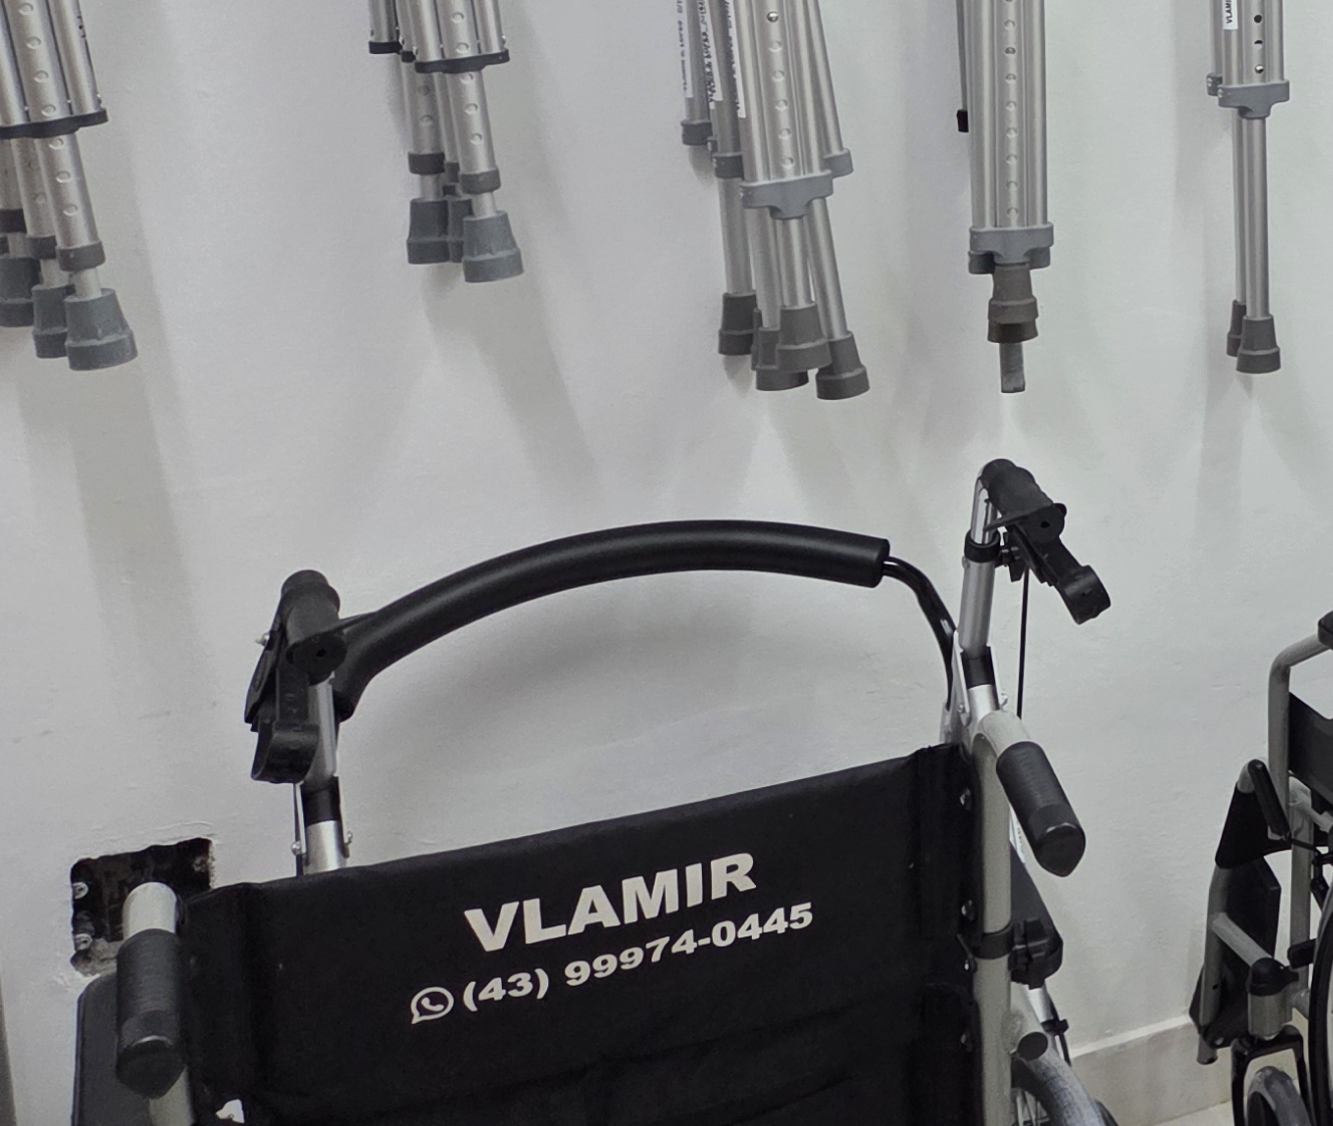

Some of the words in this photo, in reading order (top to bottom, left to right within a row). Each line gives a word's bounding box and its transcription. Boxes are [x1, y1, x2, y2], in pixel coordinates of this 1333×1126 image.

[463, 852, 757, 952] VLAMIR
[462, 968, 550, 1012] (43)
[564, 902, 814, 987] 99974-0445
